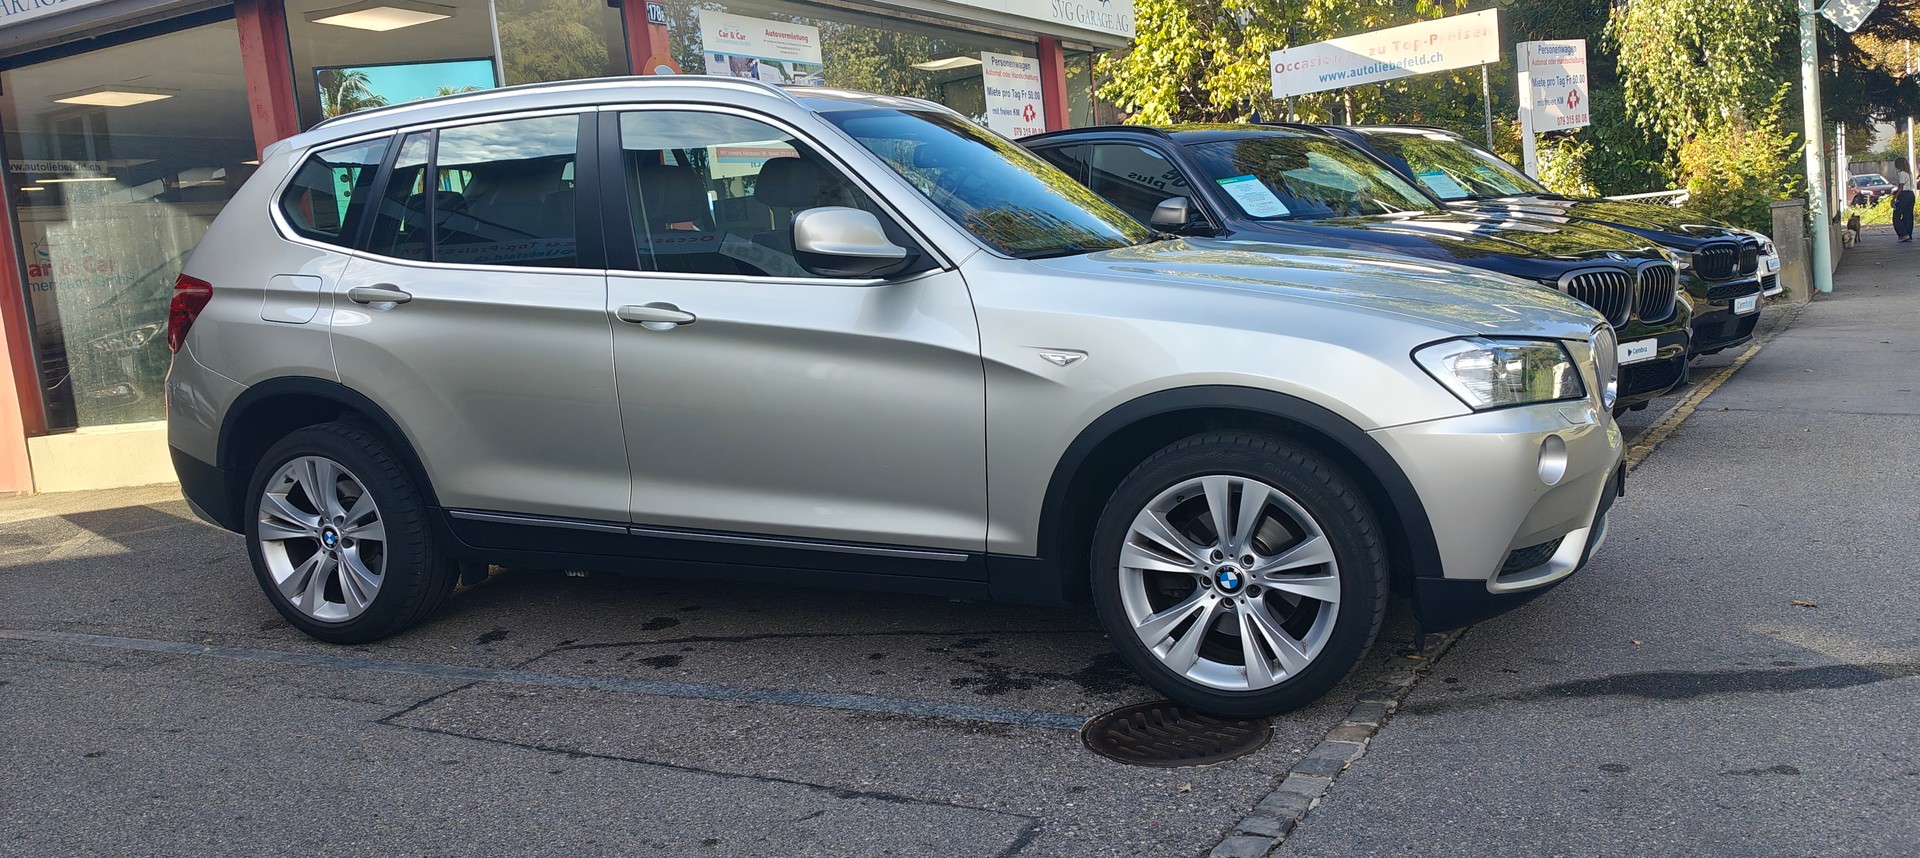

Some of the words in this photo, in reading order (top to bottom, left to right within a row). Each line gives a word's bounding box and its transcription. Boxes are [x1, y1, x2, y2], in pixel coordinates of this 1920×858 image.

[1051, 0, 1074, 21] SVG
[1076, 4, 1114, 29] GARAGE
[1115, 13, 1129, 33] AG
[718, 29, 729, 39] Car
[730, 31, 736, 39] &
[736, 32, 746, 41] Car
[764, 28, 809, 44] Autovermietung
[1369, 44, 1386, 56] zu
[1537, 45, 1577, 55] Personenwagen
[991, 55, 1031, 71] Personenwagen
[1319, 51, 1443, 83] www.autoliebefeld.ch
[1532, 58, 1548, 66] Automat
[986, 67, 1002, 77] Automat
[1532, 77, 1546, 87] Miete
[1547, 79, 1556, 88] pro
[1556, 76, 1565, 87] Tag
[1566, 75, 1572, 84] Fr
[1572, 75, 1585, 84] 50.00
[987, 86, 1001, 97] Miete
[1002, 89, 1011, 99] pro
[1011, 89, 1021, 100] Tag
[1021, 90, 1027, 98] Fr
[1028, 91, 1040, 100] 50.00
[1000, 107, 1012, 116] freien
[1557, 116, 1566, 126] 079
[1566, 115, 1574, 124] 315
[1014, 126, 1022, 136] 079
[11, 163, 101, 172] w.autoliebefd.ch
